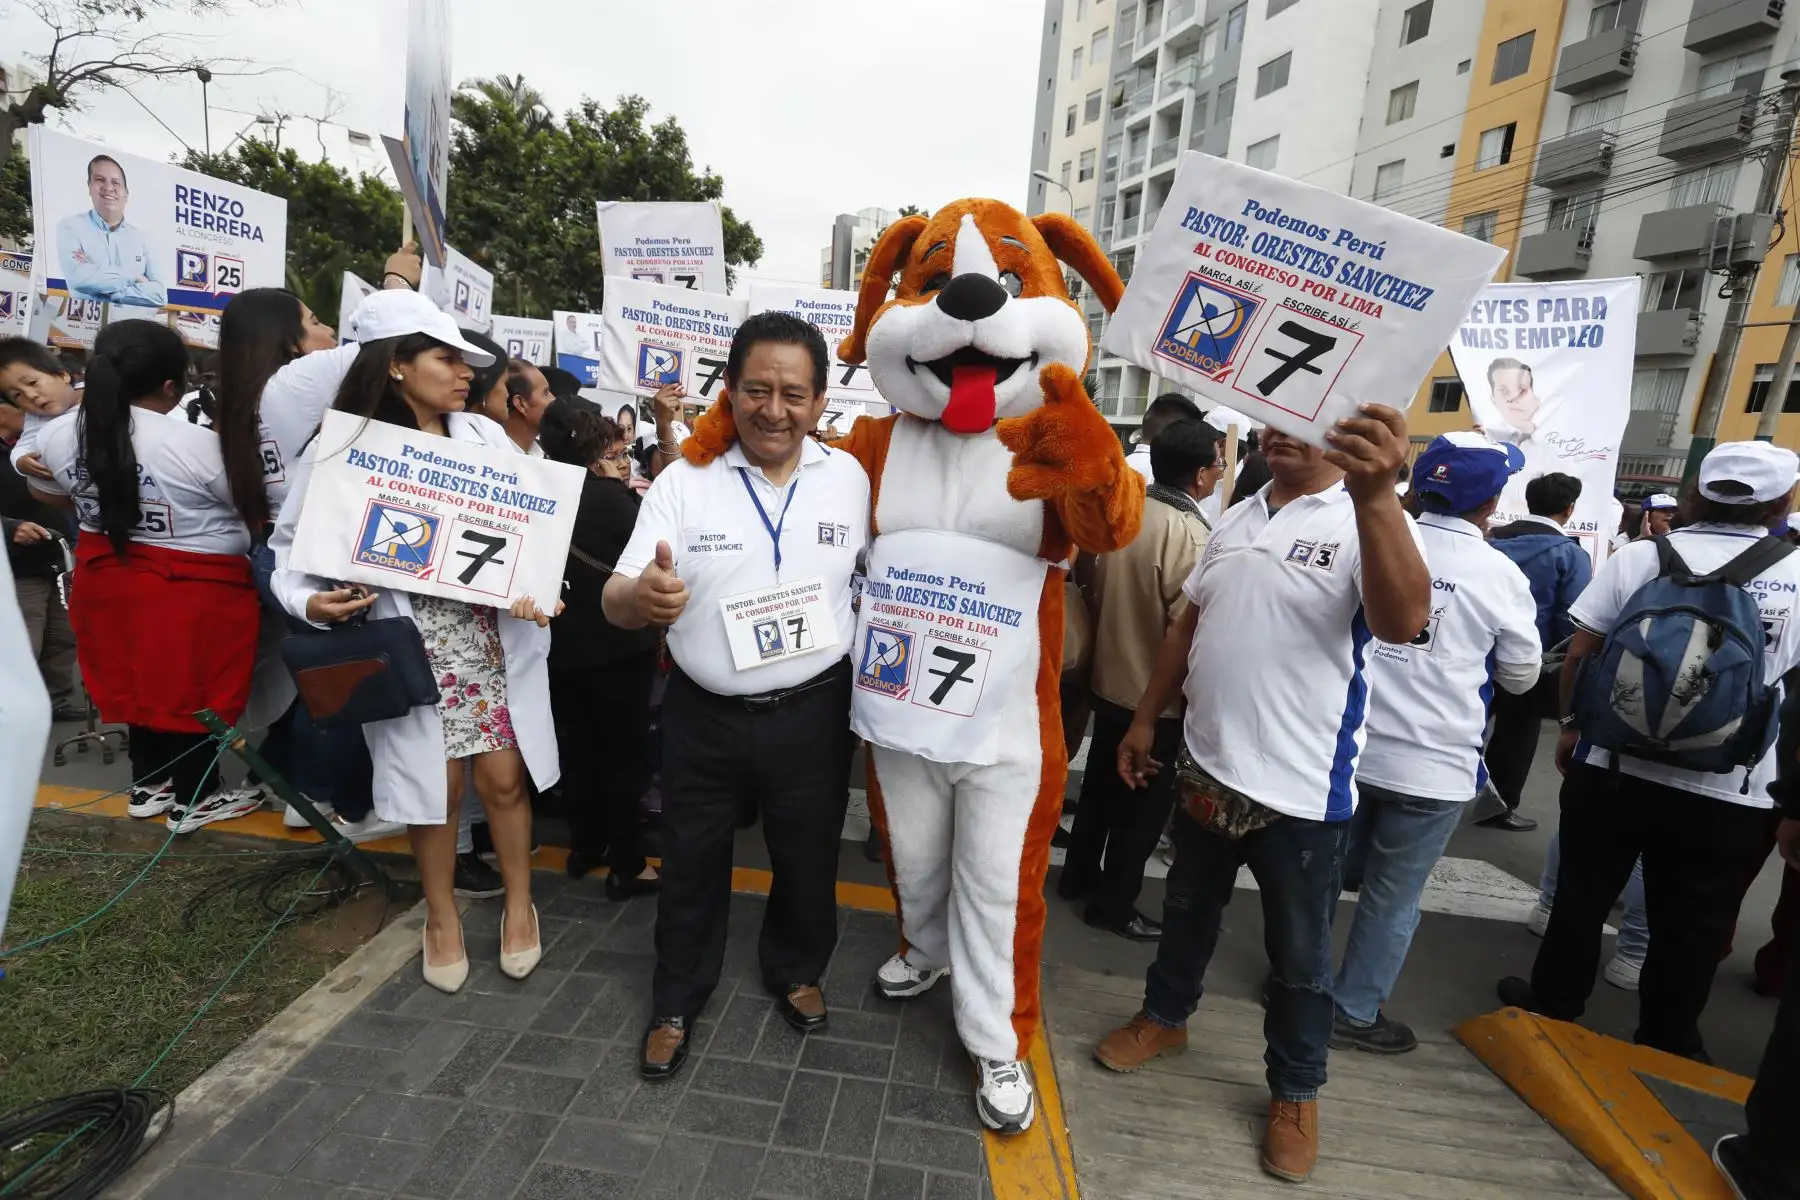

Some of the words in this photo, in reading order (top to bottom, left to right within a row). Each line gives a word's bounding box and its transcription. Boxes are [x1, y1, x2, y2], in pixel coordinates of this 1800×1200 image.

[176, 184, 244, 218] RENZO
[176, 205, 264, 243] HERRERA
[176, 226, 186, 236] AL
[188, 230, 234, 246] CONGRESO
[1241, 198, 1331, 242] Podemos
[1332, 228, 1387, 261] Perú
[614, 247, 645, 257] PASTOR:
[646, 247, 680, 257] ORESTES
[682, 246, 714, 256] SANCHEZ
[635, 237, 670, 245] Podemos
[2, 258, 31, 272] CONG
[1181, 206, 1249, 249] PASTOR:
[1251, 232, 1340, 279] ORESTES
[1335, 260, 1435, 311] SANCHEZ
[217, 265, 241, 288] 25
[1193, 242, 1213, 258] AL
[1215, 249, 1300, 288] CONGRESO
[1300, 279, 1338, 302] POR
[1338, 292, 1384, 319] LIMA
[1198, 265, 1233, 284] MARCA
[1235, 279, 1255, 292] ASÍ
[86, 299, 100, 321] 35
[652, 300, 700, 317] Podemos
[703, 309, 729, 322] Perú
[795, 299, 842, 311] Podemos
[1282, 297, 1330, 321] ESCRIBE
[1328, 315, 1350, 328] ASÍ
[1464, 298, 1530, 324] EYES
[1536, 296, 1608, 323] PARA
[622, 307, 663, 326] PASTOR:
[665, 316, 711, 335] ORESTES
[807, 312, 853, 326] ORESTES
[636, 324, 647, 333] AL
[649, 327, 697, 342] CONGRESO
[699, 335, 719, 346] POR
[1460, 327, 1509, 350] MAS
[1515, 324, 1604, 350] EMPLEO
[1160, 339, 1222, 371] PODEMOS
[1256, 320, 1337, 397] 7
[696, 357, 728, 397] 7
[401, 444, 477, 475] Podemos
[480, 465, 519, 485] Perú
[346, 448, 414, 479] PASTOR:
[418, 467, 489, 499] ORESTES
[490, 486, 557, 515] SANCHEZ
[366, 475, 385, 488] AL
[388, 480, 464, 507] CONGRESO
[467, 500, 495, 515] POR
[498, 508, 530, 524] LIMA
[378, 493, 411, 506] MARCA
[457, 513, 495, 528] ESCRIBE
[1579, 521, 1599, 531] ASÍ
[687, 544, 712, 553] ORESTES
[714, 543, 743, 551] SANCHEZ
[699, 534, 726, 542] PASTOR
[839, 531, 846, 545] 7
[361, 551, 423, 573] PODEMOS
[456, 529, 507, 585] 7
[1315, 549, 1332, 567] 3
[886, 566, 945, 586] Podemos
[948, 576, 986, 595] Perú
[726, 599, 756, 612] PASTOR:
[757, 591, 790, 604] ORESTES
[790, 583, 822, 594] SANCHEZ
[735, 612, 745, 621] AL
[745, 603, 784, 618] CONGRESO
[785, 599, 800, 608] POR
[801, 594, 819, 604] LIMA
[895, 585, 958, 612] ORESTES
[959, 597, 1023, 628] SANCHEZ
[787, 616, 807, 649] 7
[881, 604, 935, 622] CONGRESO
[937, 614, 965, 629] POR
[967, 621, 999, 637] LIMA
[928, 628, 963, 642] ESCRIBE
[1374, 650, 1409, 663] Podemos
[1377, 644, 1402, 655] Juntos
[928, 646, 976, 706] 7
